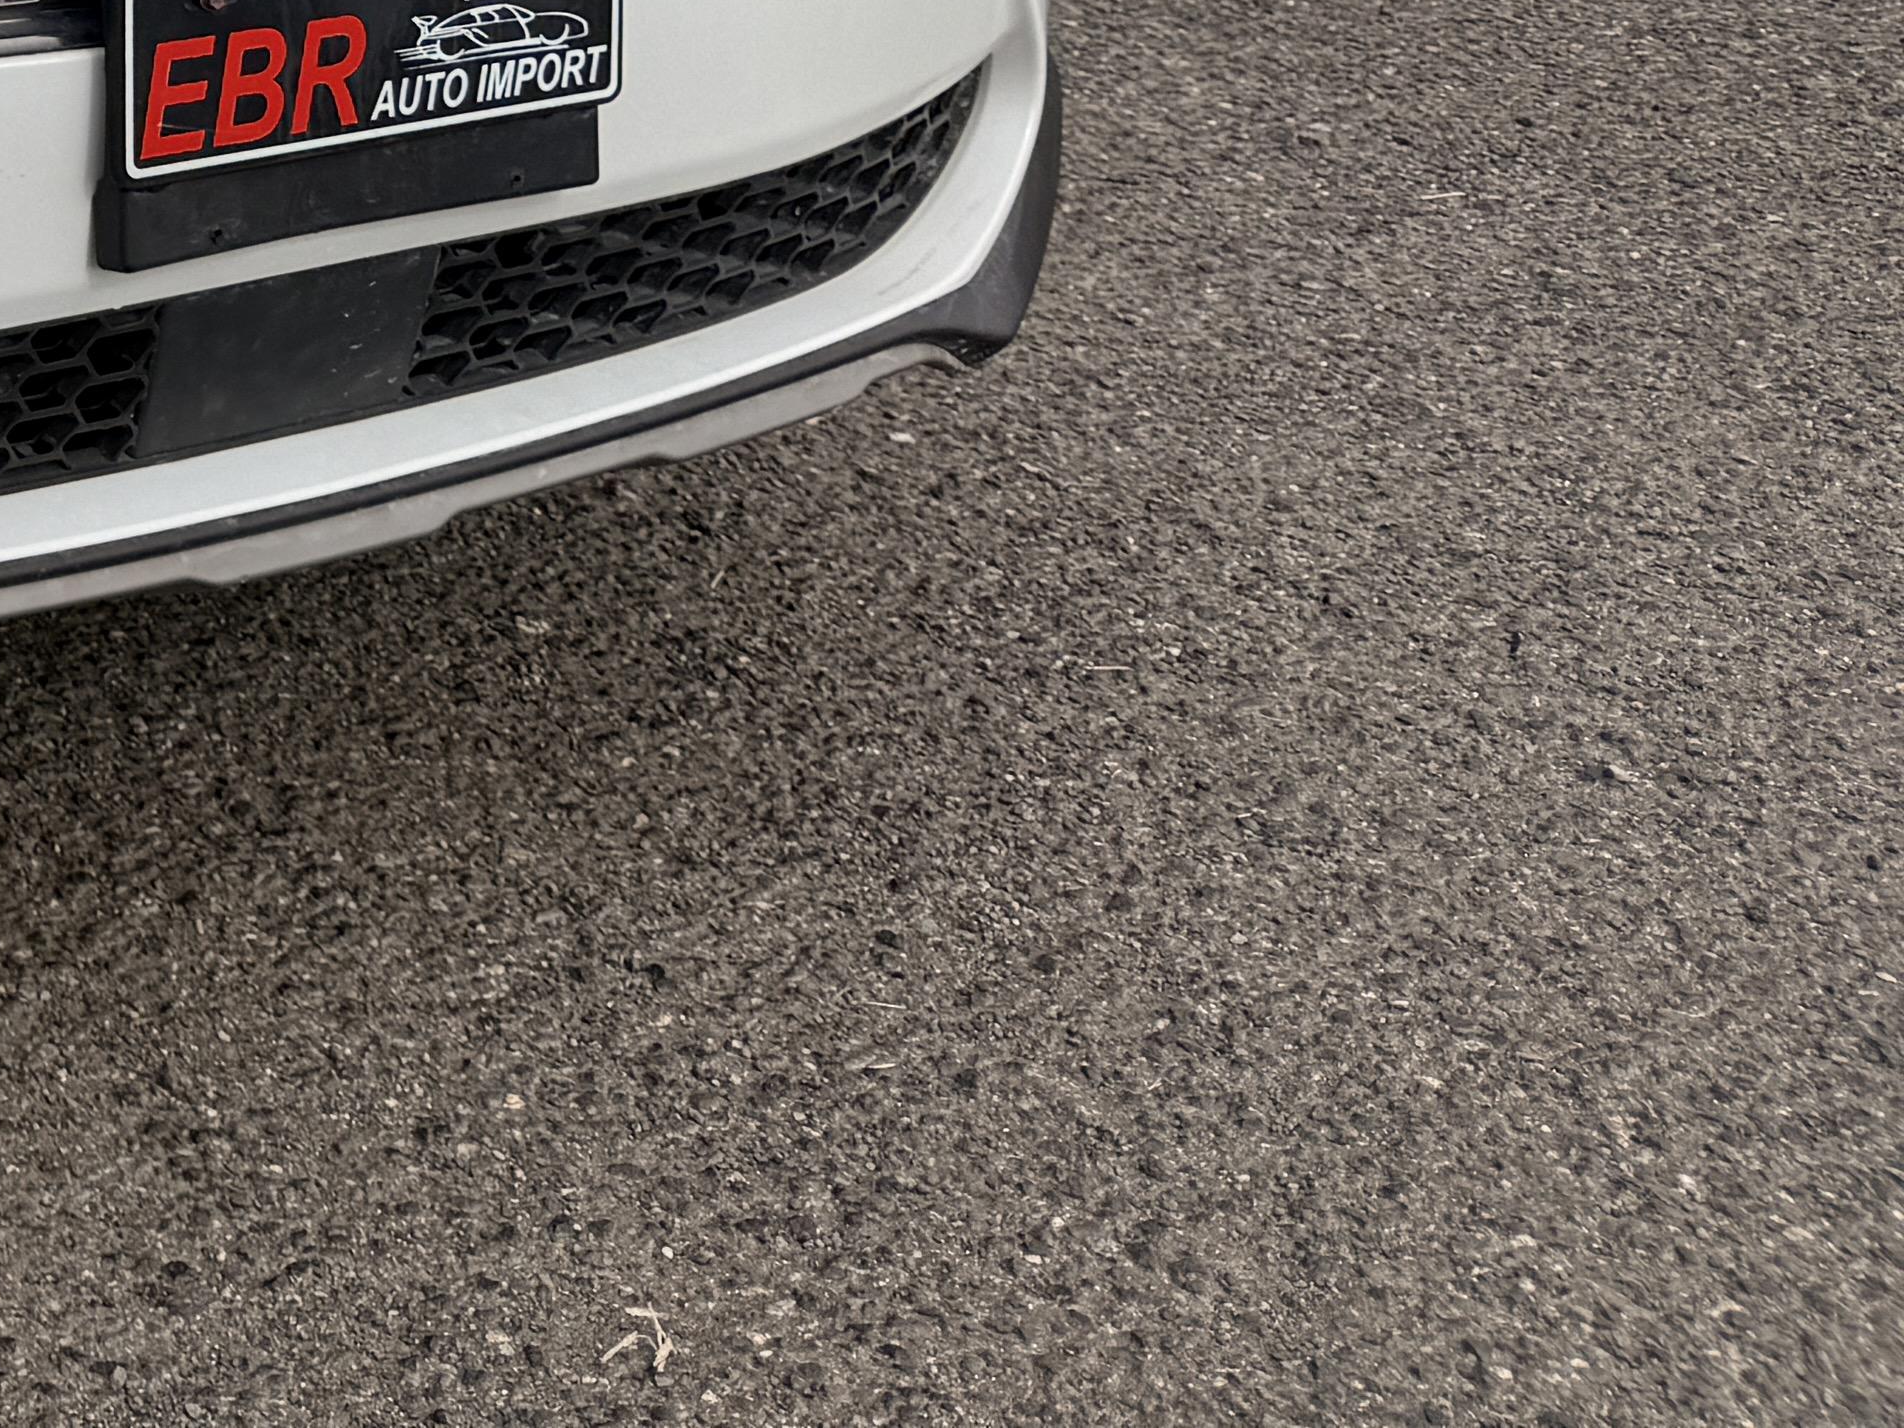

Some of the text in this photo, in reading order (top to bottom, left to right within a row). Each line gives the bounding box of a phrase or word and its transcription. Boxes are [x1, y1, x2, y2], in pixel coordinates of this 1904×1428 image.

[139, 14, 368, 161] EBR
[370, 44, 608, 121] AUTO IMPORT
